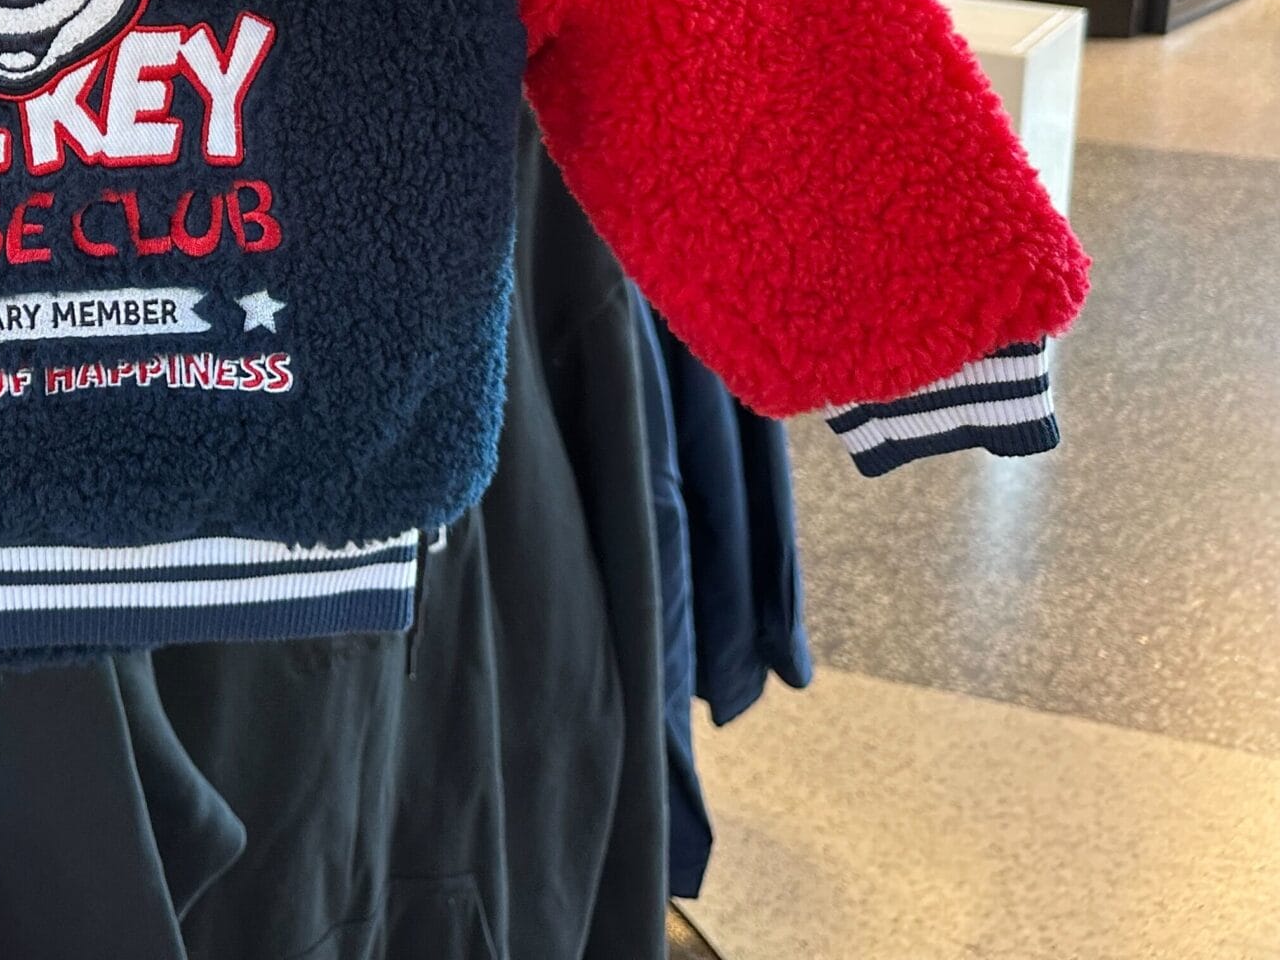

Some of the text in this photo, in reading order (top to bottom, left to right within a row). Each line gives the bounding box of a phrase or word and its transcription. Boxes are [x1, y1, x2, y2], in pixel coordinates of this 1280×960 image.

[71, 179, 282, 258] CLUB
[51, 298, 178, 329] MEMBER
[44, 353, 293, 395] HAPPINESS
